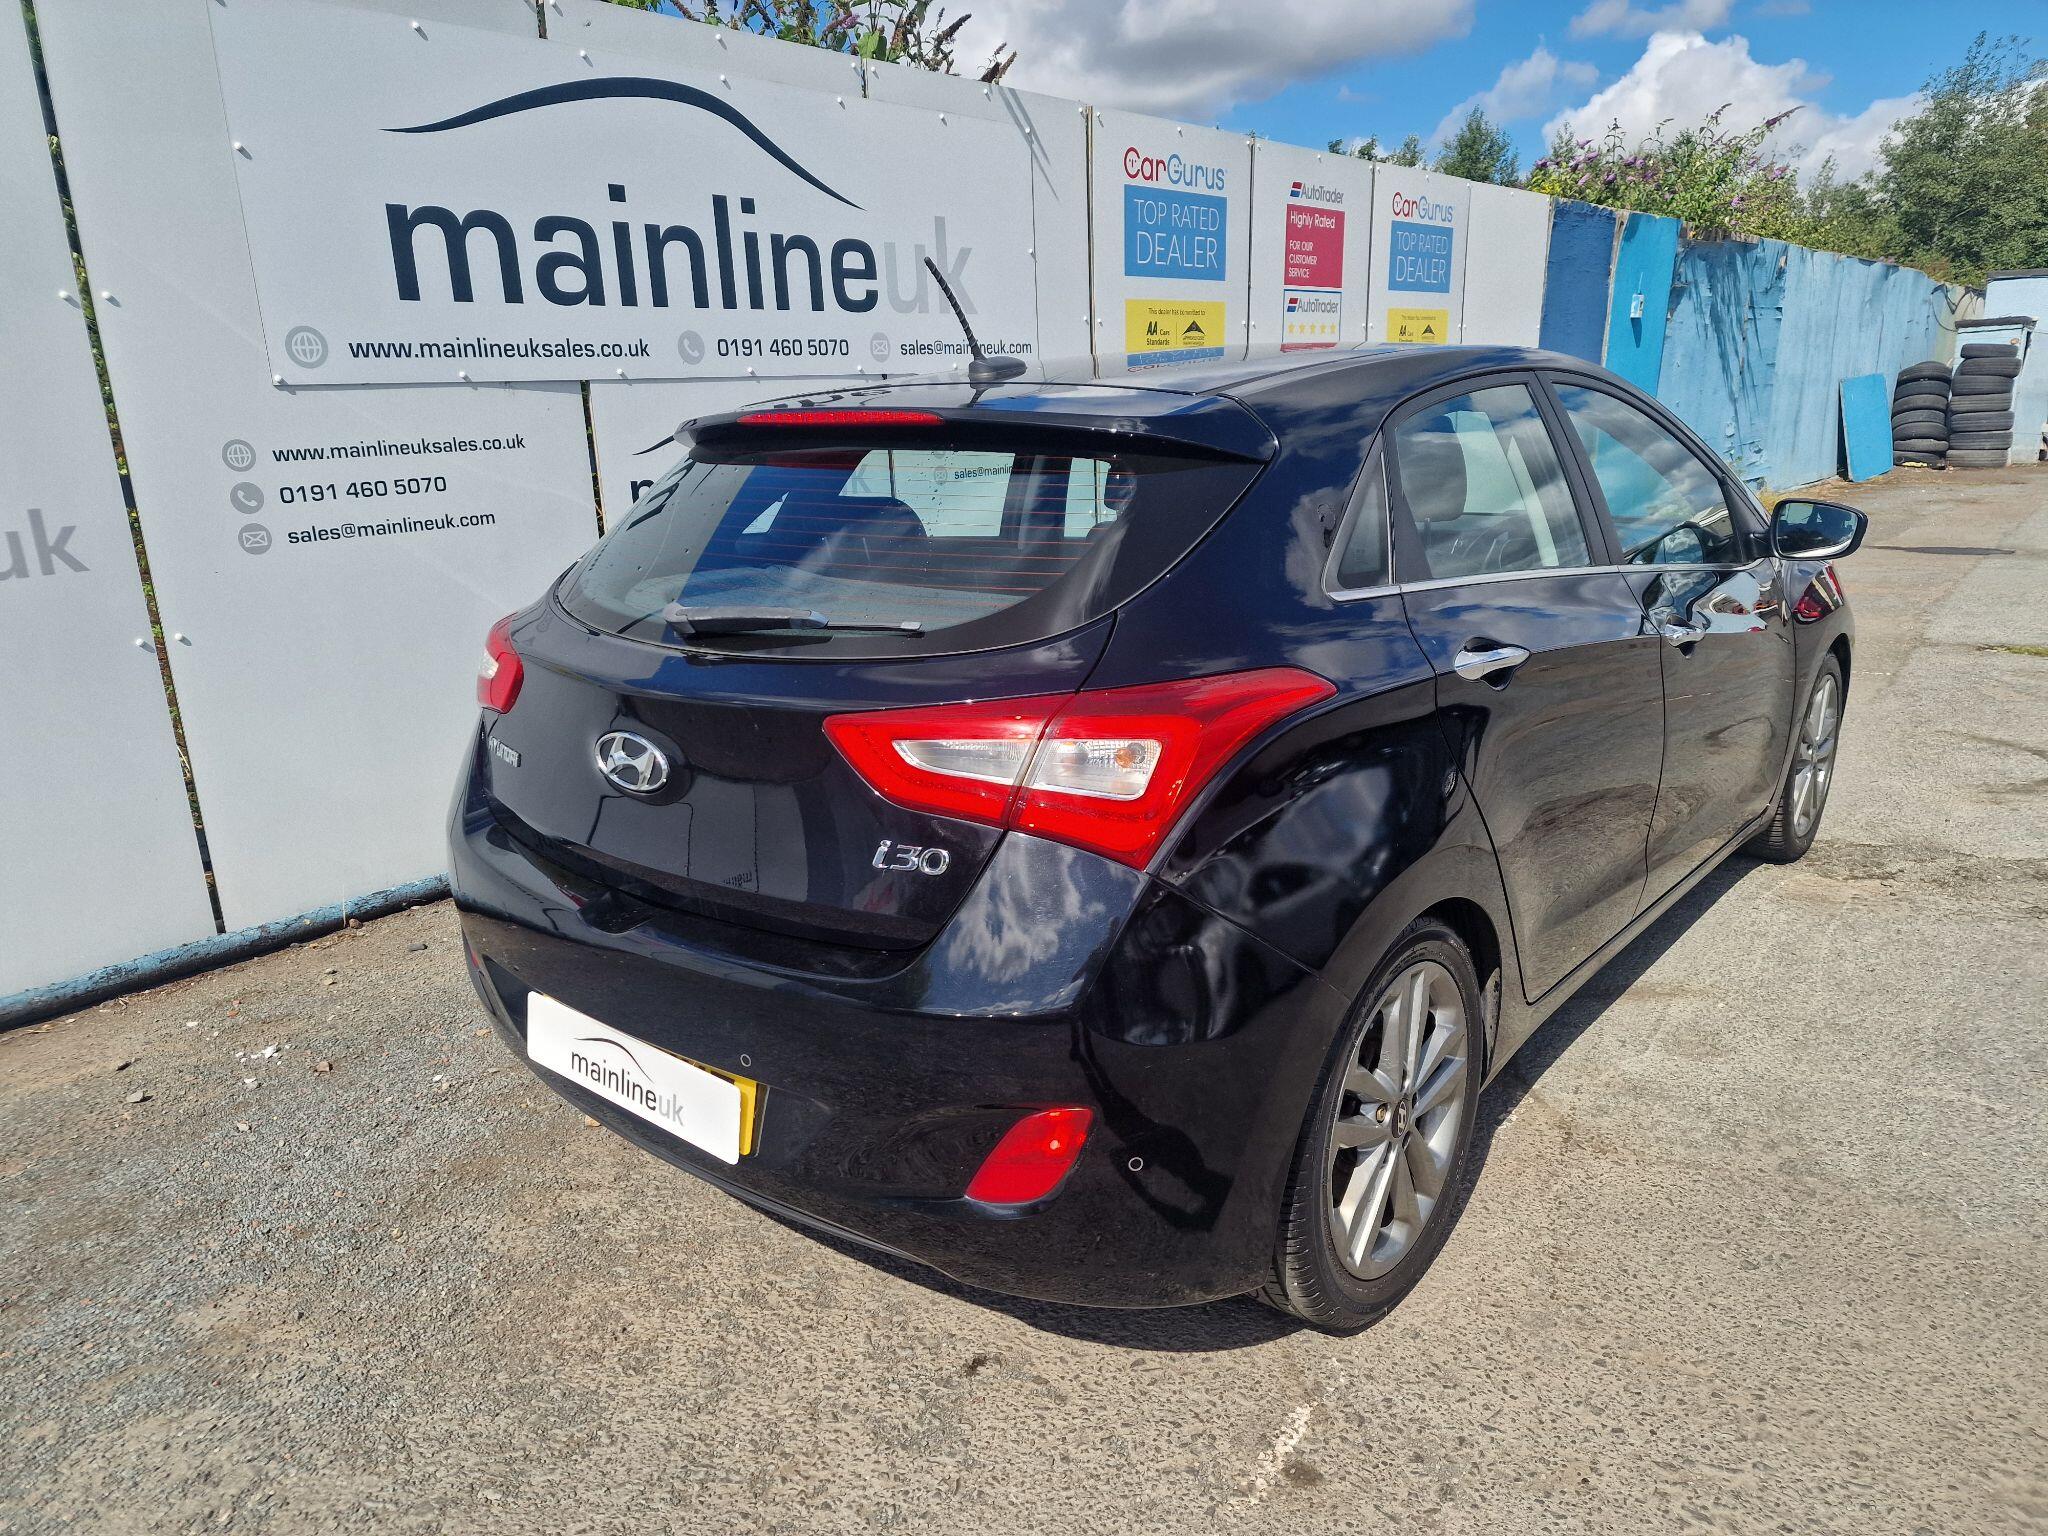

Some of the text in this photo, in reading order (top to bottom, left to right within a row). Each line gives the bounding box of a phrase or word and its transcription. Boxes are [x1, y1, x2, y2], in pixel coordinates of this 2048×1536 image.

[1123, 146, 1225, 190] CarGurus
[1300, 183, 1344, 204] AutoTrader
[1392, 191, 1453, 222] CarGurus
[1134, 199, 1220, 231] TOP RATED
[1290, 211, 1336, 229] Highly Rated
[385, 183, 979, 315] mainlineuk
[1137, 231, 1218, 269] DEALER
[1289, 240, 1314, 252] FOR OUR
[1396, 231, 1449, 255] TOP RATED
[1288, 253, 1318, 265] CUSTOMER
[1395, 255, 1446, 283] DEALER
[1288, 267, 1310, 278] SERVICE
[1296, 298, 1339, 313] AutoTrader
[1146, 321, 1158, 335] AA
[348, 337, 651, 359] www.mainlineuksales.co.uk
[717, 338, 850, 357] 0191 460 5070
[1146, 338, 1170, 346] Standards
[272, 433, 526, 462] www.mainlineuksales.co.uk
[279, 476, 448, 504] 0191 460 5070
[287, 512, 496, 544] sales@mainlineuk.com
[872, 839, 951, 876] i30
[571, 1050, 686, 1127] mainlineuk
